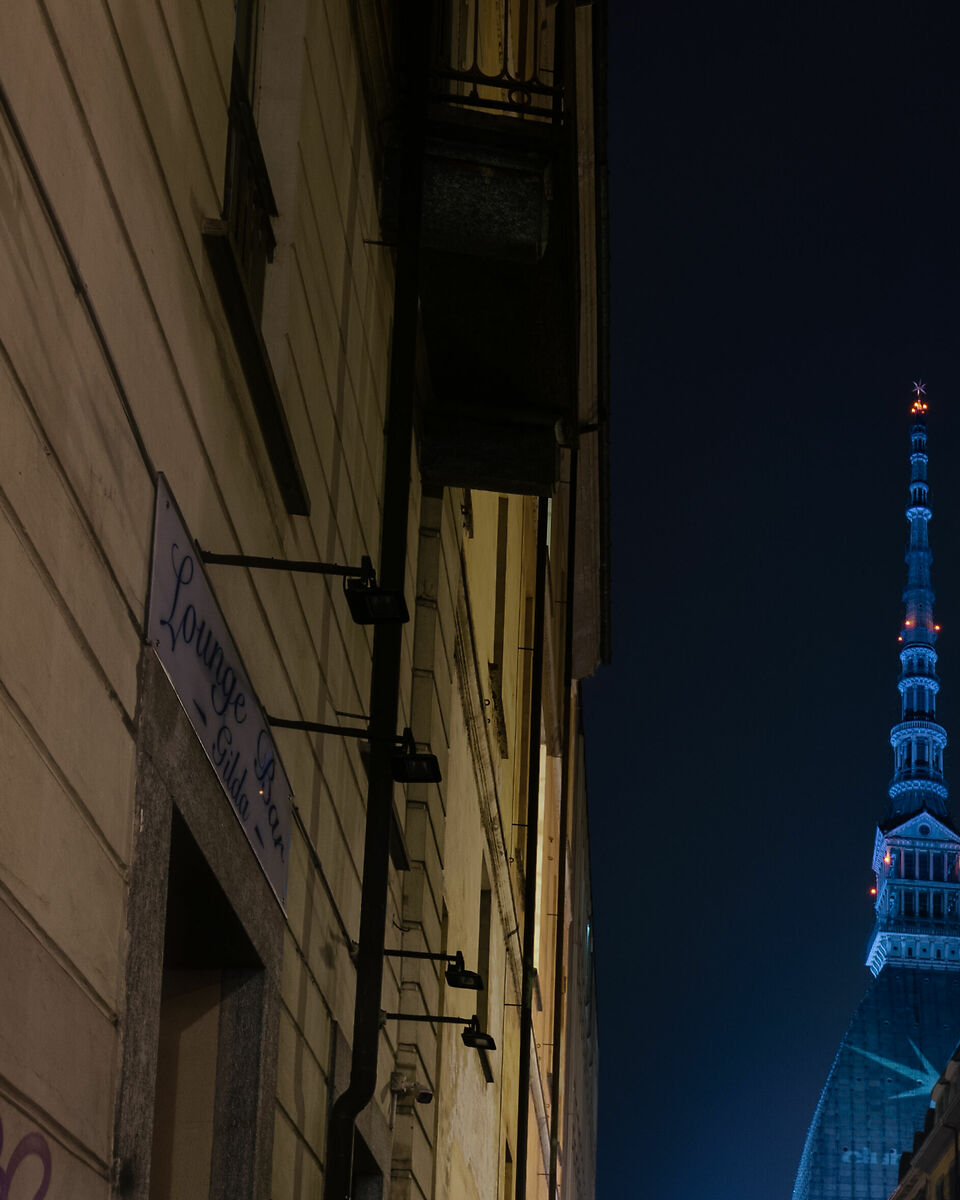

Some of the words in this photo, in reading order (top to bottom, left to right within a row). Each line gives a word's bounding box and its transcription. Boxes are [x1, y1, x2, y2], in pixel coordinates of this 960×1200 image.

[160, 543, 247, 724] Lounge
[254, 729, 285, 863] Bar
[211, 725, 249, 822] Gilda
